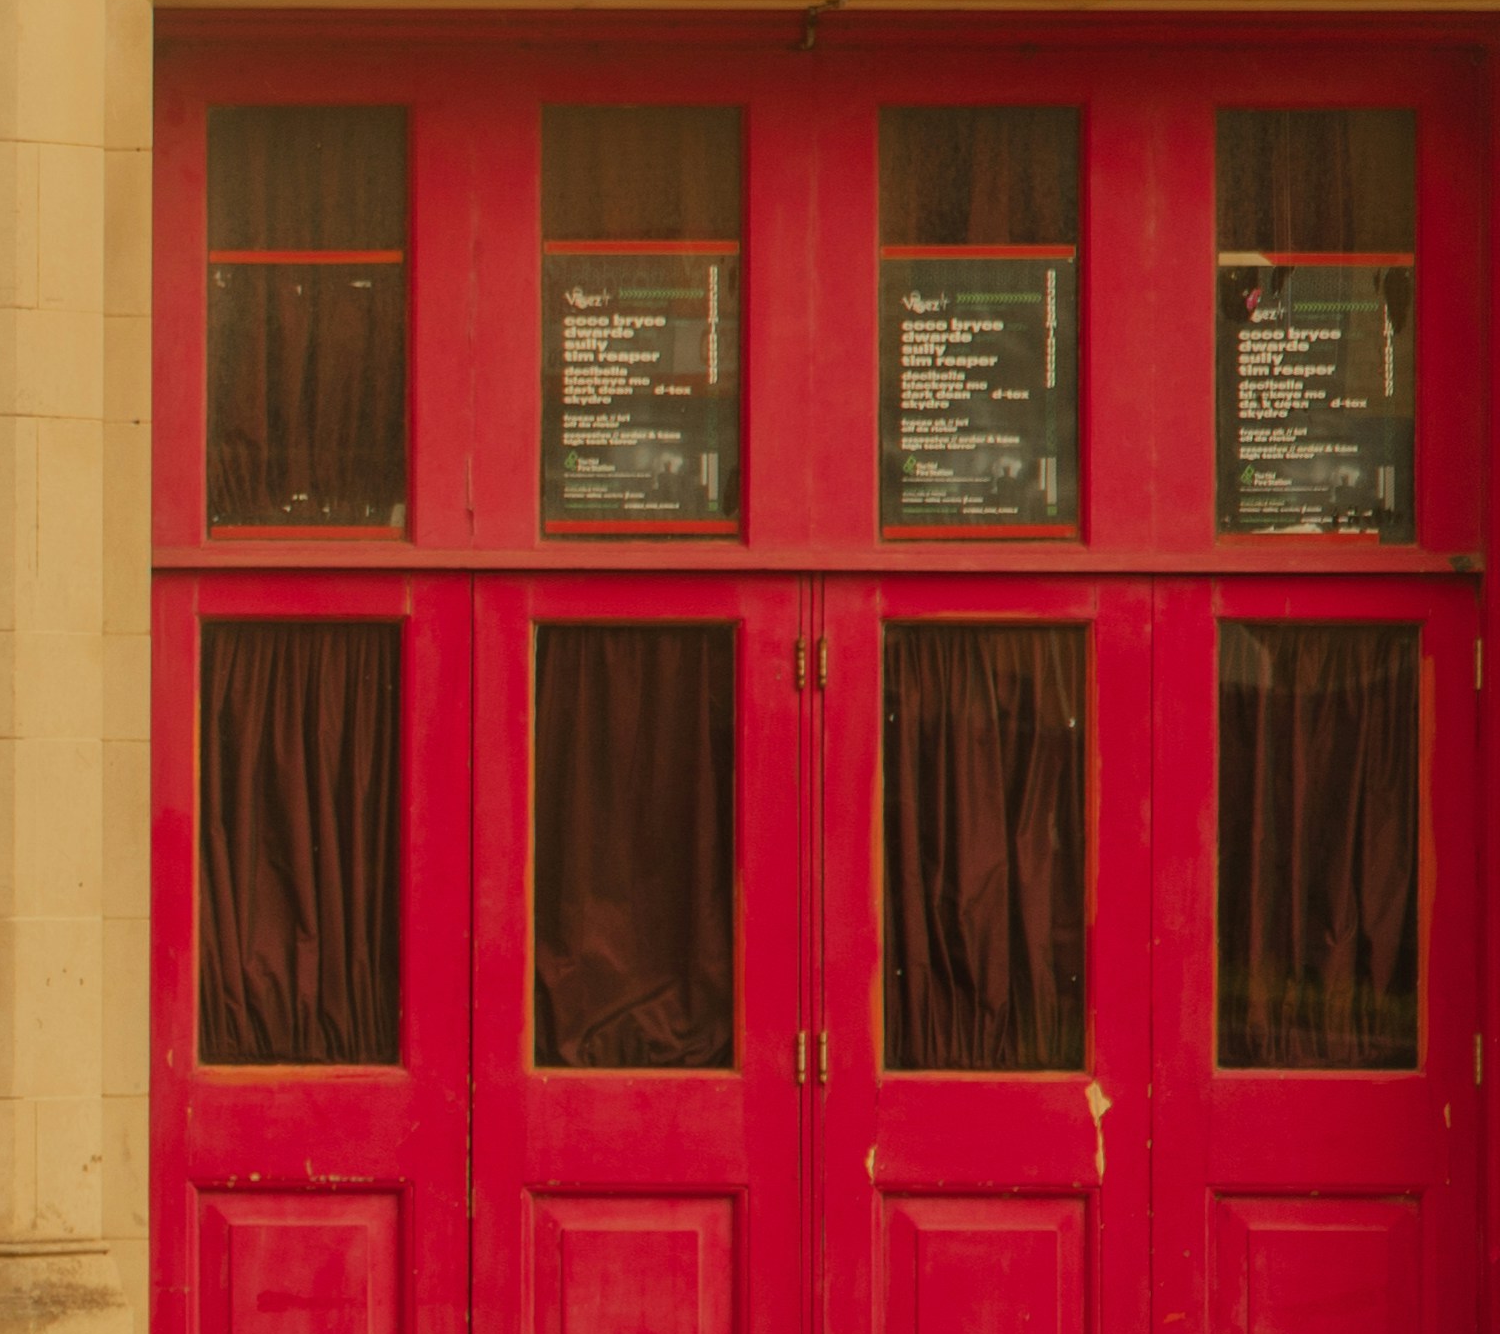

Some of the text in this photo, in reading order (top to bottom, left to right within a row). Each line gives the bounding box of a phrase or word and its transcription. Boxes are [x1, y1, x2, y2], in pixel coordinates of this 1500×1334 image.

[564, 314, 666, 328] coco bryce
[902, 318, 1004, 333] coco bryce
[564, 327, 634, 338] dwarde
[902, 332, 972, 343] dwarde
[1239, 327, 1341, 342] coco bryce
[564, 339, 608, 351] sully
[902, 343, 946, 356] sully
[1239, 341, 1309, 352] dwarde
[564, 351, 660, 364] tim reaper
[902, 356, 998, 369] tim reaper
[1239, 352, 1283, 365] sully
[1239, 365, 1336, 378] tim reaper
[564, 386, 595, 395] dark
[902, 390, 933, 399] dark
[1239, 390, 1301, 400] blckeye
[564, 395, 611, 406] skydro
[901, 400, 949, 410] skydro
[1239, 409, 1287, 420] skydro
